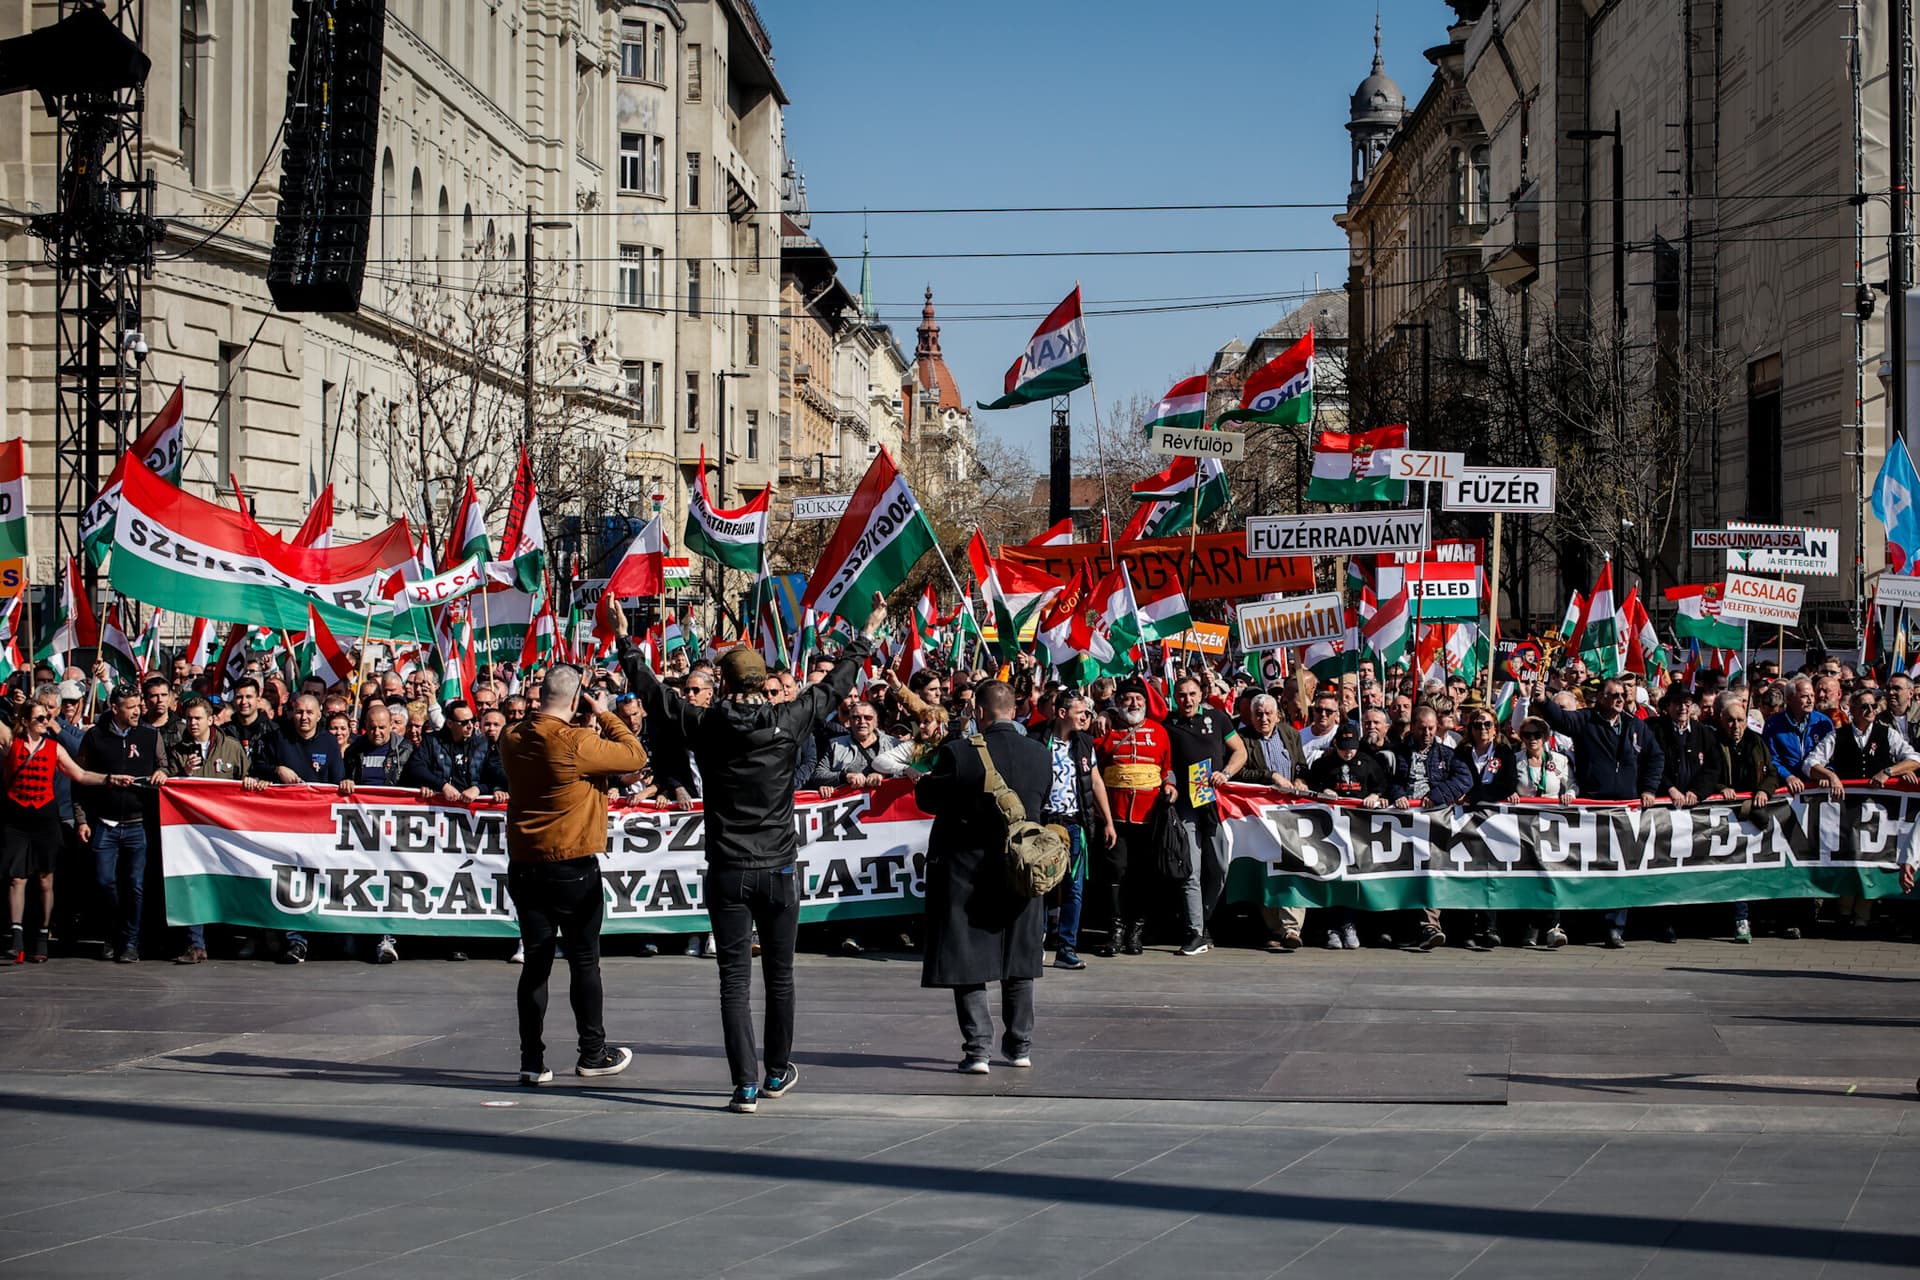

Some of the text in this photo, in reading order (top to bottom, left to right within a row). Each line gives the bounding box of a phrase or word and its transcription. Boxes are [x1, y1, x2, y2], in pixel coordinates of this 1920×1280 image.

[1162, 432, 1233, 456] Révfülöp
[1399, 453, 1454, 479] SZIL
[1457, 474, 1540, 504] FÜZÉR
[1253, 517, 1423, 550] FÜZÉRRADVÁNY
[1694, 533, 1802, 547] KISKUNMAJSA
[1437, 543, 1476, 562] WAR
[377, 566, 480, 602] KRCSA
[1413, 583, 1469, 596] BELED
[1731, 579, 1798, 604] ACSALAG
[1244, 602, 1340, 646] NYÍRKÁTA
[1499, 641, 1517, 652] STOP
[336, 808, 506, 852] NEM
